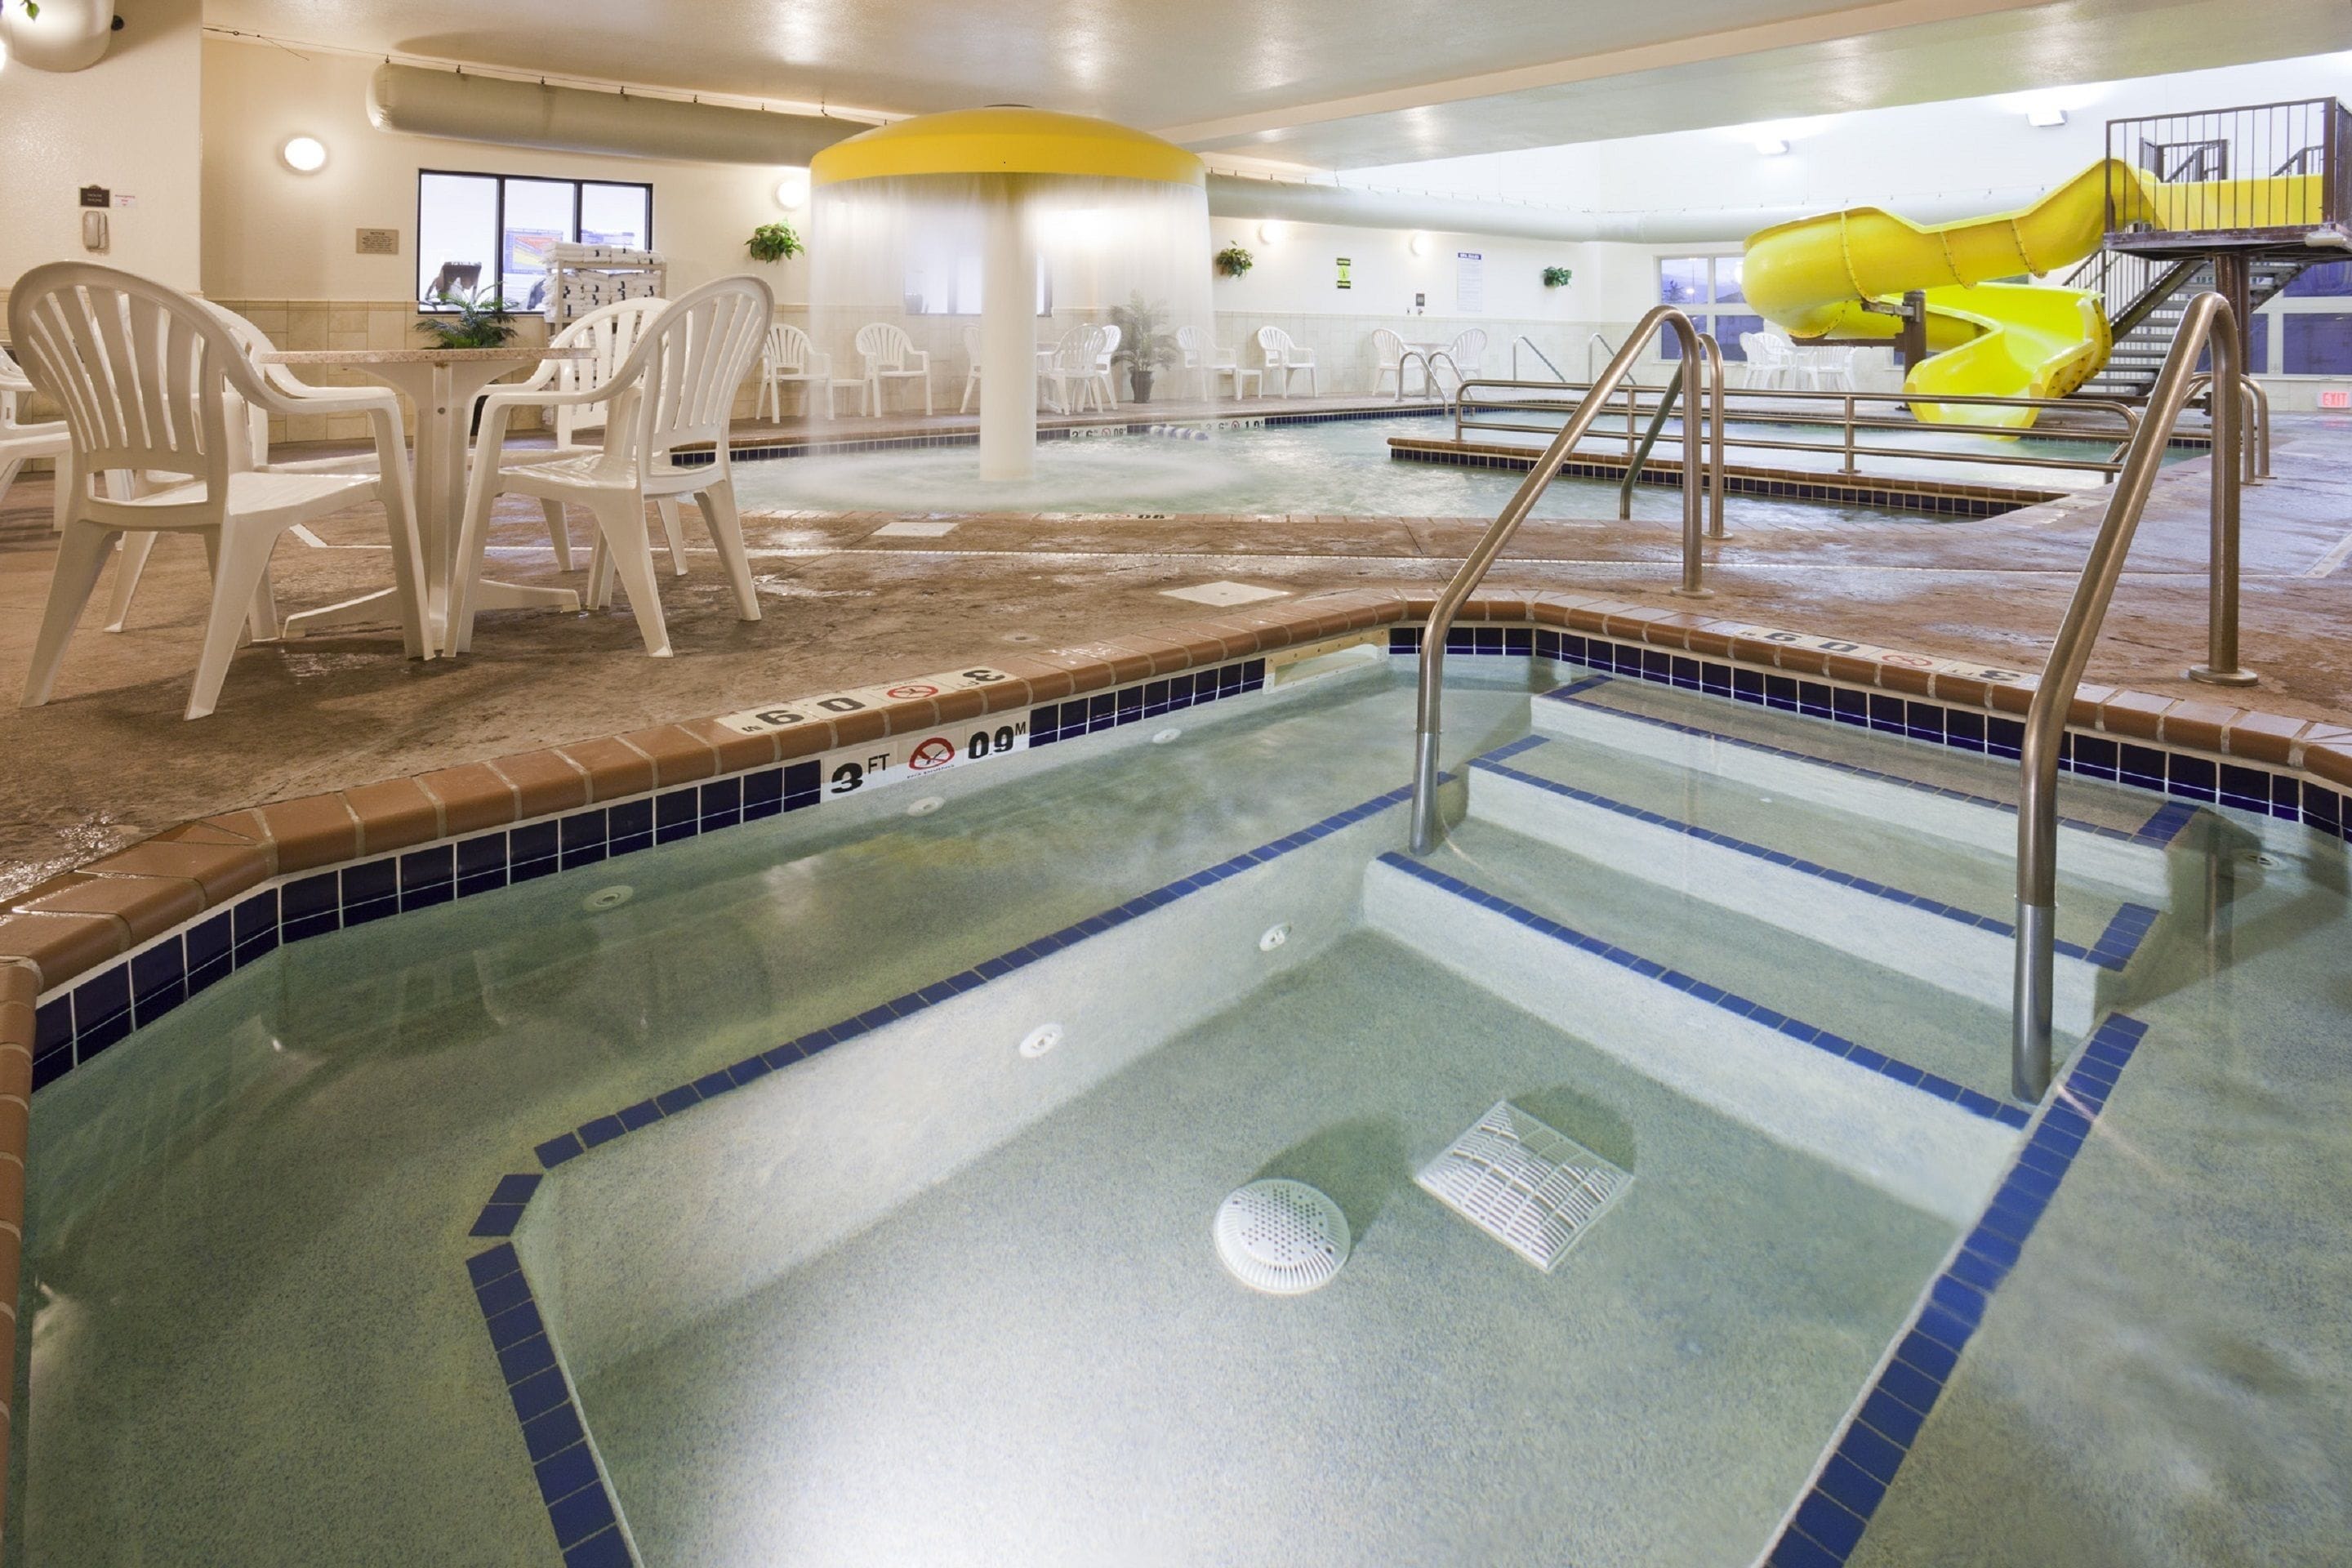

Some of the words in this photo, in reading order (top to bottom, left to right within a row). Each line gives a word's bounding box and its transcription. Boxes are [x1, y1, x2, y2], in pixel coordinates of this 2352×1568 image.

[2323, 392, 2348, 406] EXIT
[963, 670, 1006, 683] 3
[831, 762, 864, 794] 3
[868, 753, 890, 775] FT
[1015, 721, 1027, 737] M
